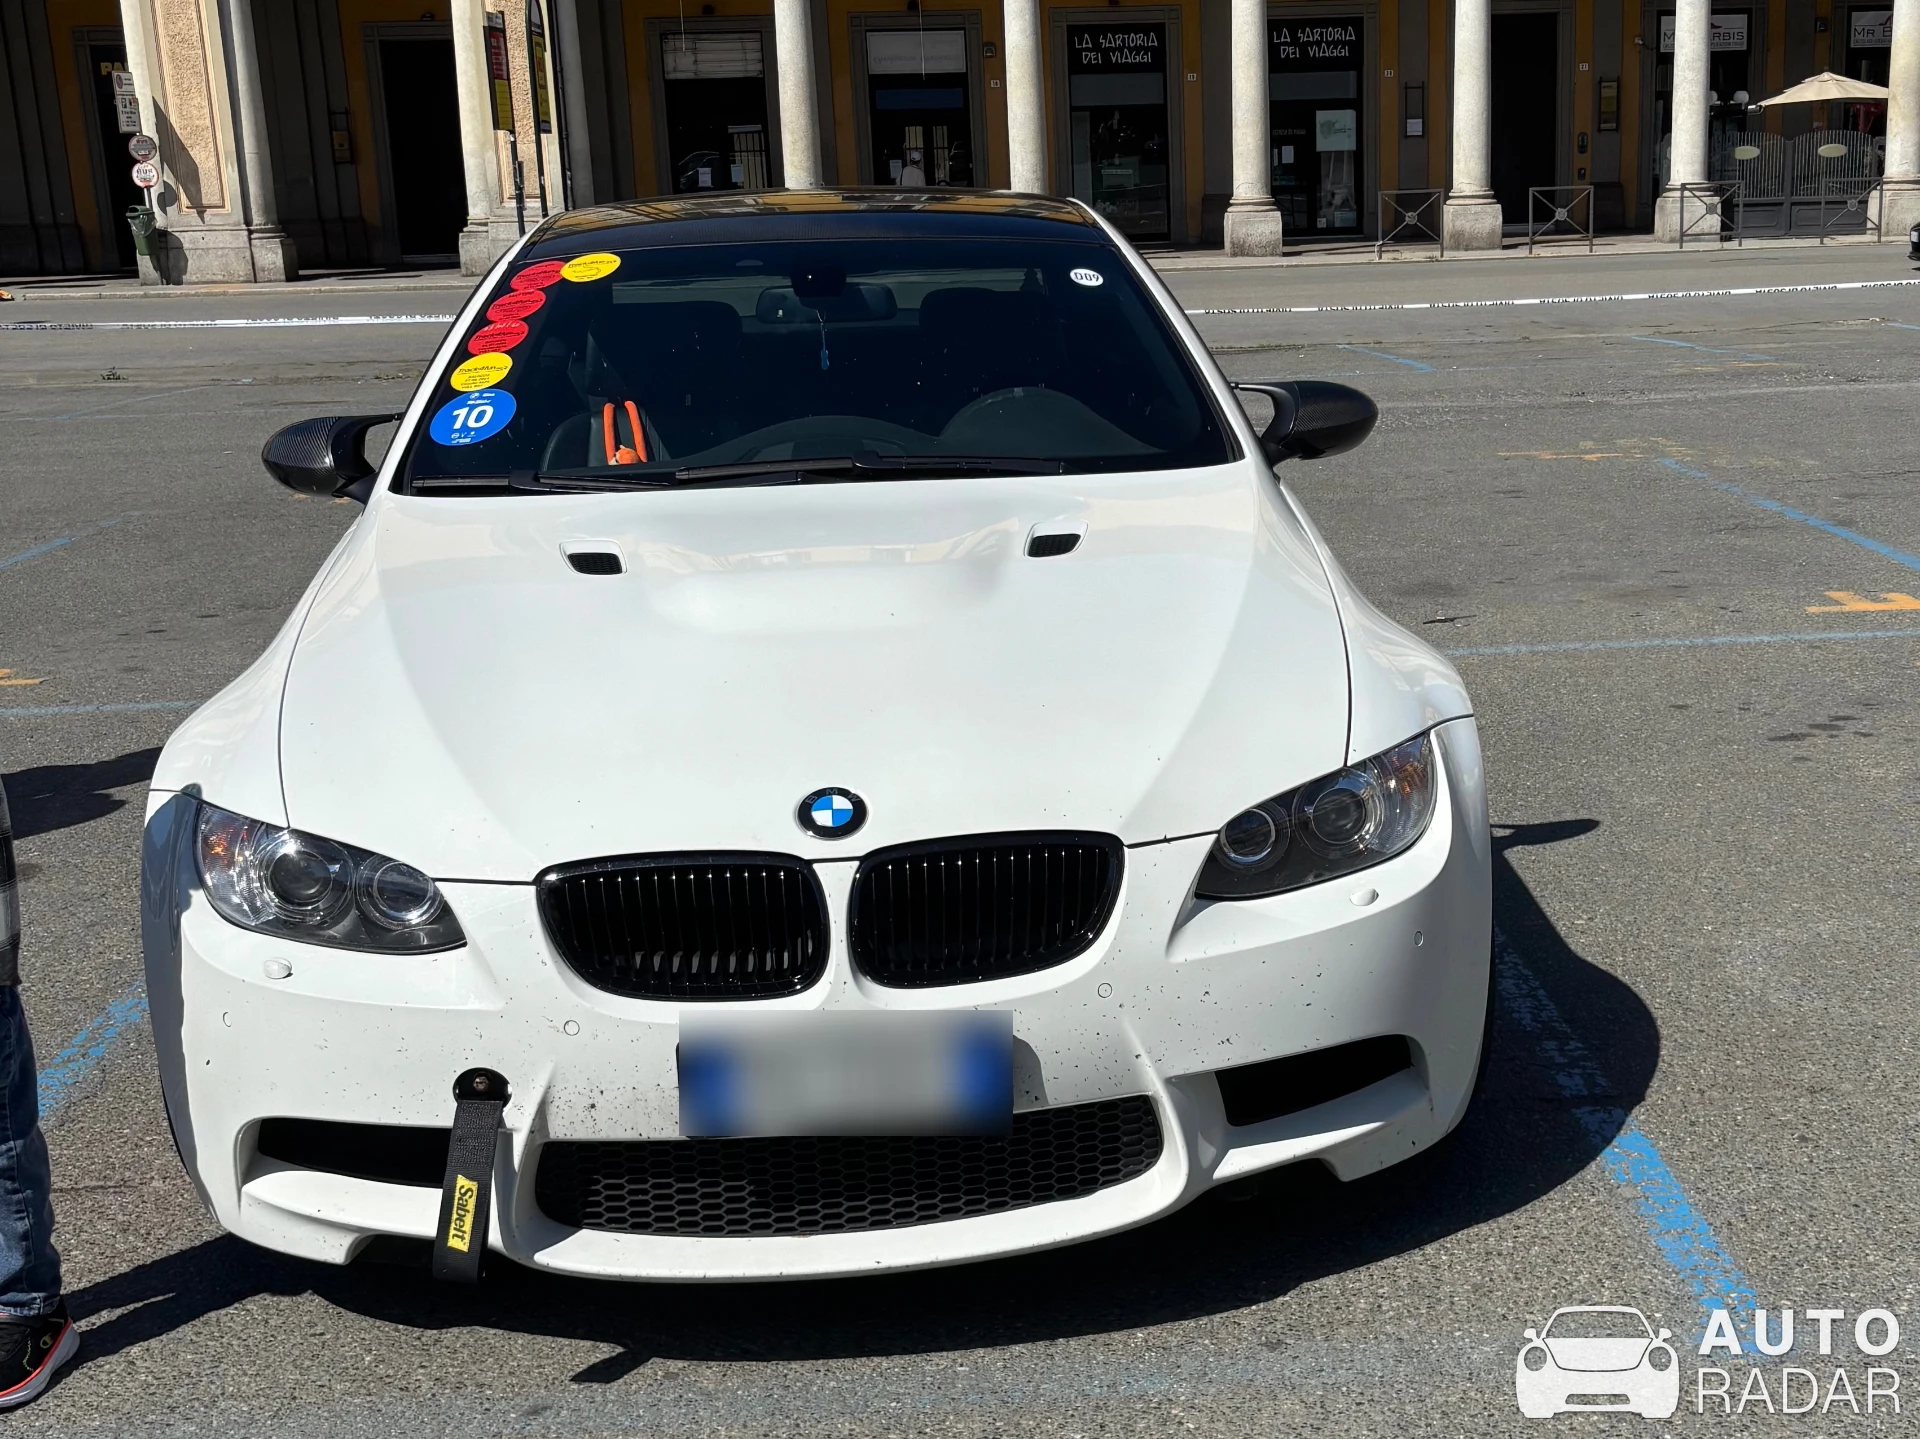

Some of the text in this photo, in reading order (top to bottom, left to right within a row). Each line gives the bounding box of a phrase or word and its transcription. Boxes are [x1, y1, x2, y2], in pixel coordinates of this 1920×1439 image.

[1075, 32, 1158, 48] LA SARTORIA
[1273, 26, 1355, 42] LA SARTORIA
[1712, 31, 1744, 41] RBIS
[1082, 48, 1151, 64] DEI VIAGGI
[1281, 43, 1349, 58] DEI VIAGGI
[1074, 272, 1099, 282] D09
[452, 405, 494, 430] 10
[805, 788, 861, 804] BMW
[452, 1184, 474, 1242] Sabelt
